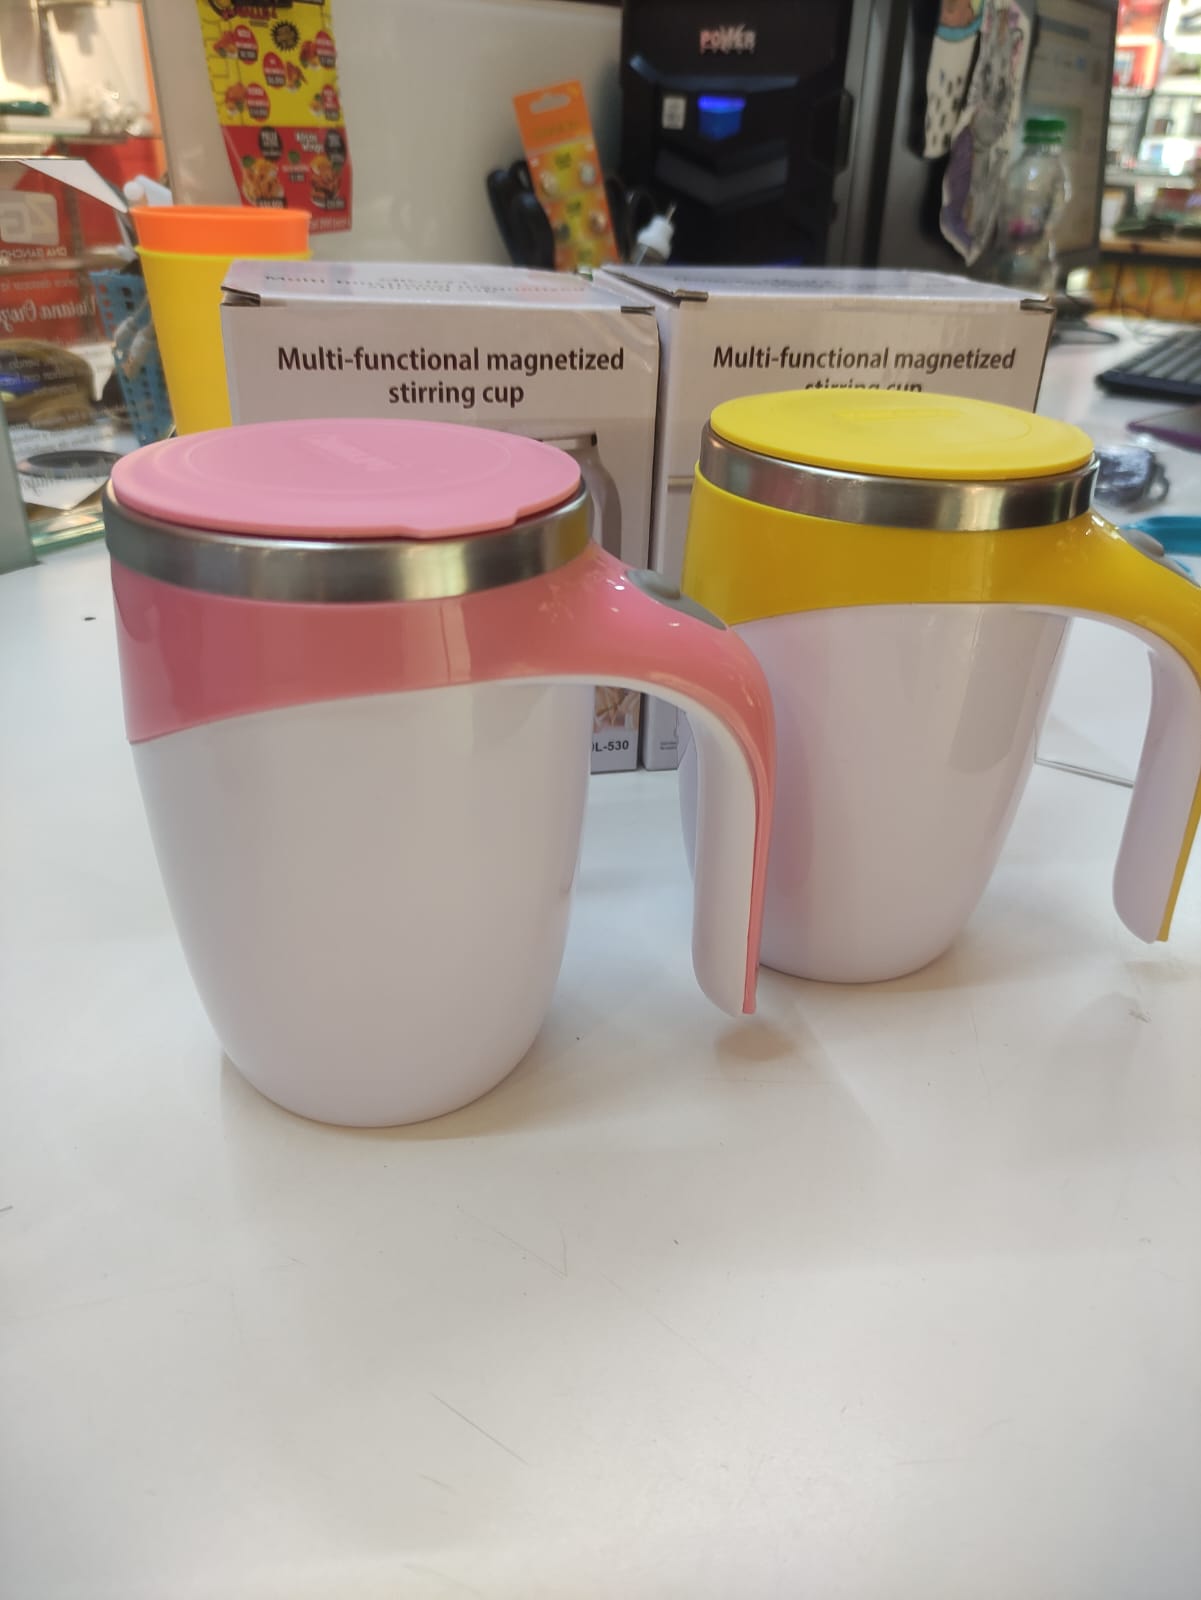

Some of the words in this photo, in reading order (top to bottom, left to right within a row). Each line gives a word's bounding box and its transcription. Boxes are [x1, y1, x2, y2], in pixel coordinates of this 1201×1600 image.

[277, 346, 479, 371] Multi-functional
[486, 347, 624, 376] magnetized
[713, 346, 888, 370] Multi-functional
[893, 348, 1017, 375] magnetized
[388, 381, 475, 409] stirring
[483, 385, 525, 409] cup
